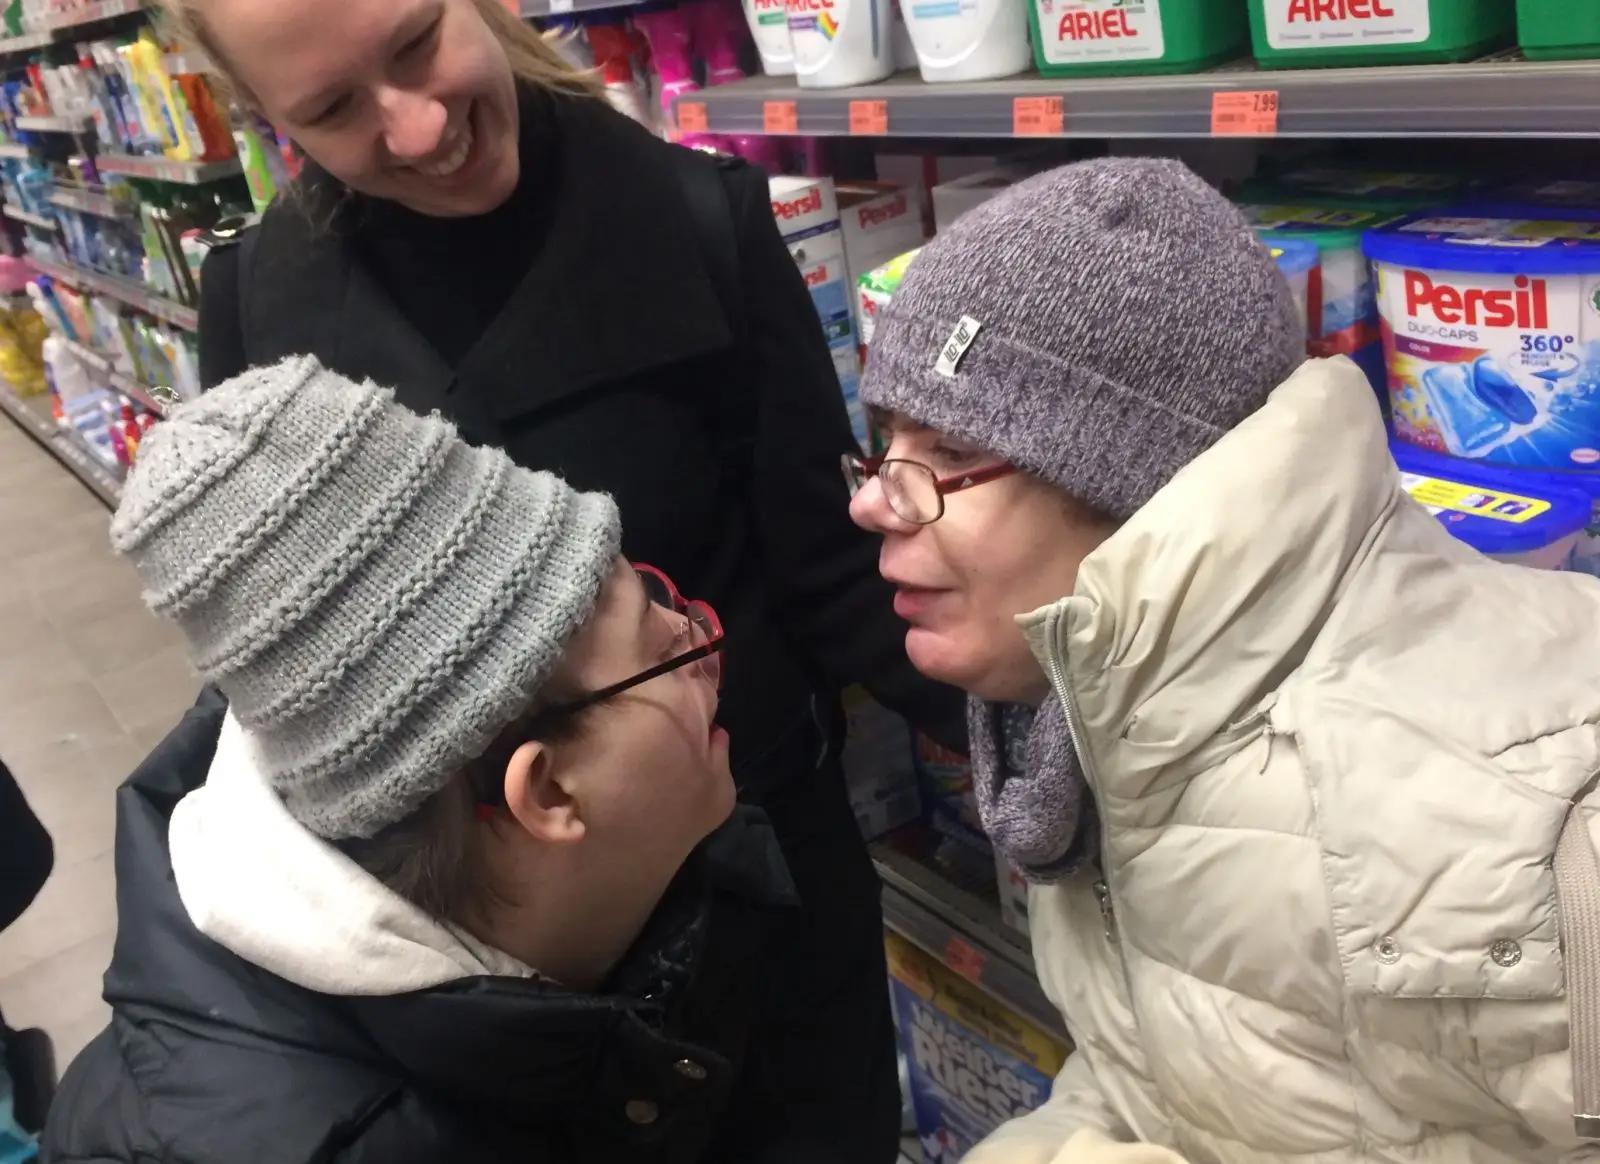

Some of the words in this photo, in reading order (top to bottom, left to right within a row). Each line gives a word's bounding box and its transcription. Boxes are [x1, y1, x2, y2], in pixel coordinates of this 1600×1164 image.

[1058, 8, 1138, 41] ARIEL
[1287, 0, 1394, 23] ARIEL
[771, 188, 822, 219] Persil
[859, 195, 907, 229] Persil
[1404, 270, 1548, 330] Persil
[910, 1022, 1035, 1122] Ries
